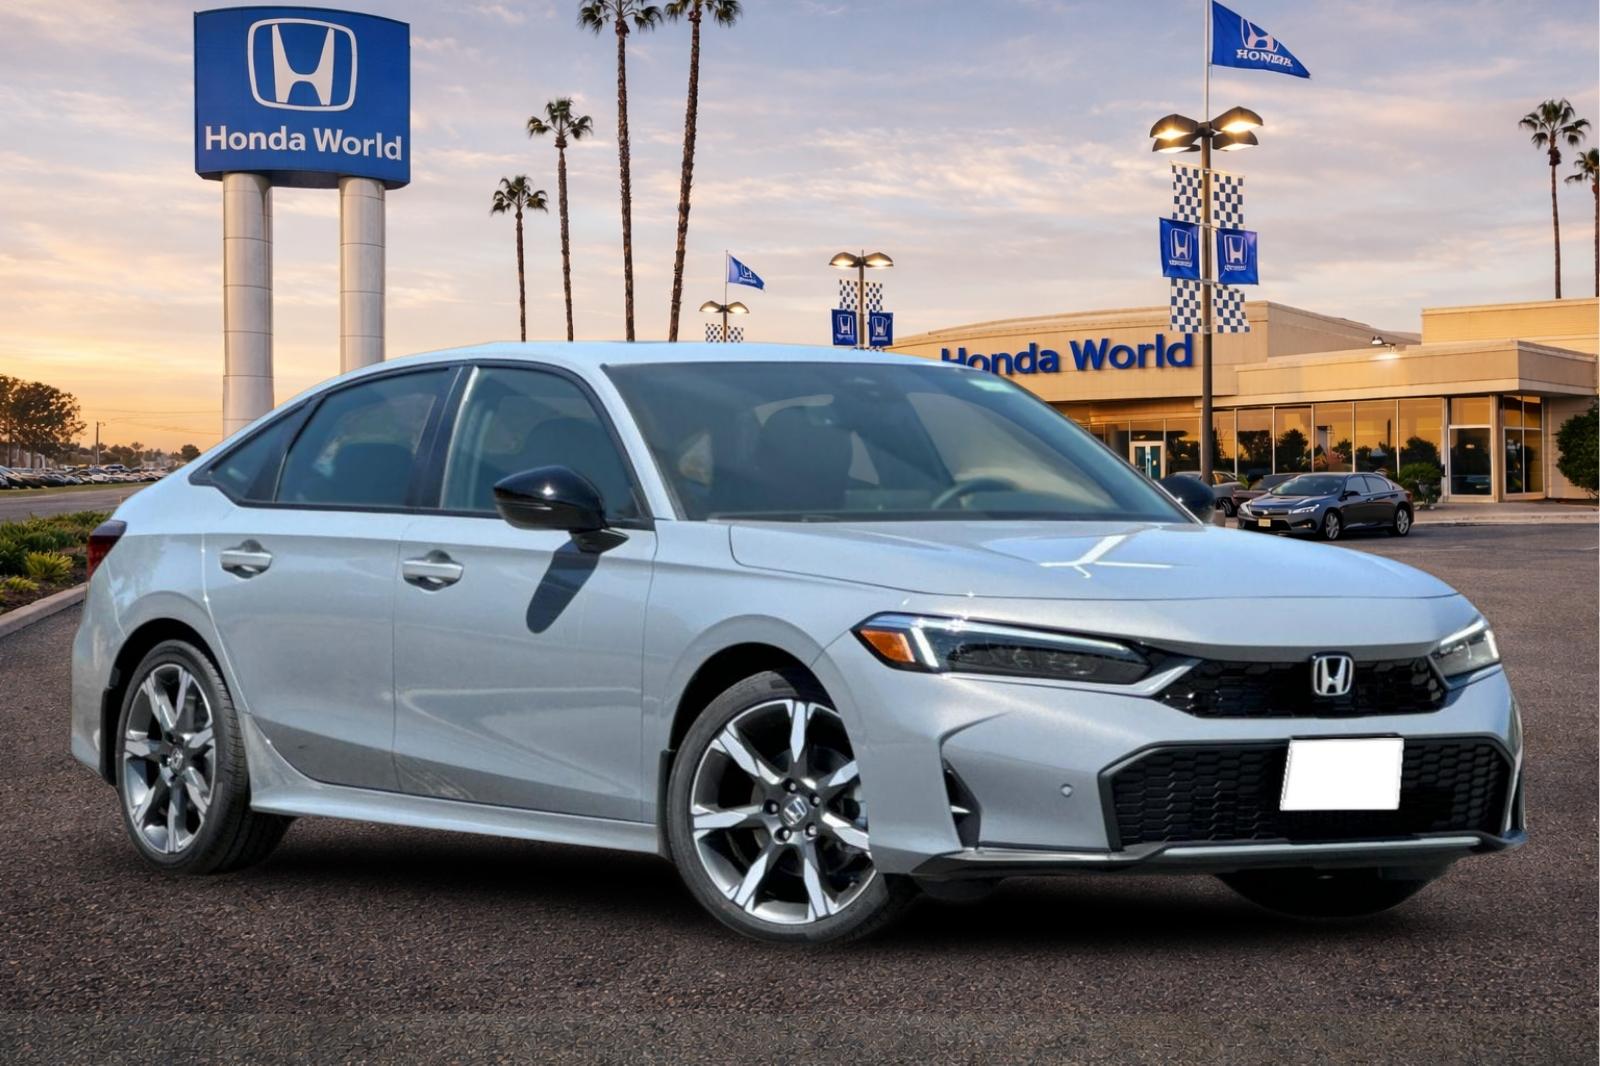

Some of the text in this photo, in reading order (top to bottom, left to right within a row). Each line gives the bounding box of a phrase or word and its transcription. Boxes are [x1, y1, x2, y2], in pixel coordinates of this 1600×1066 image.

[205, 125, 402, 161] Honda World
[1069, 333, 1194, 371] World
